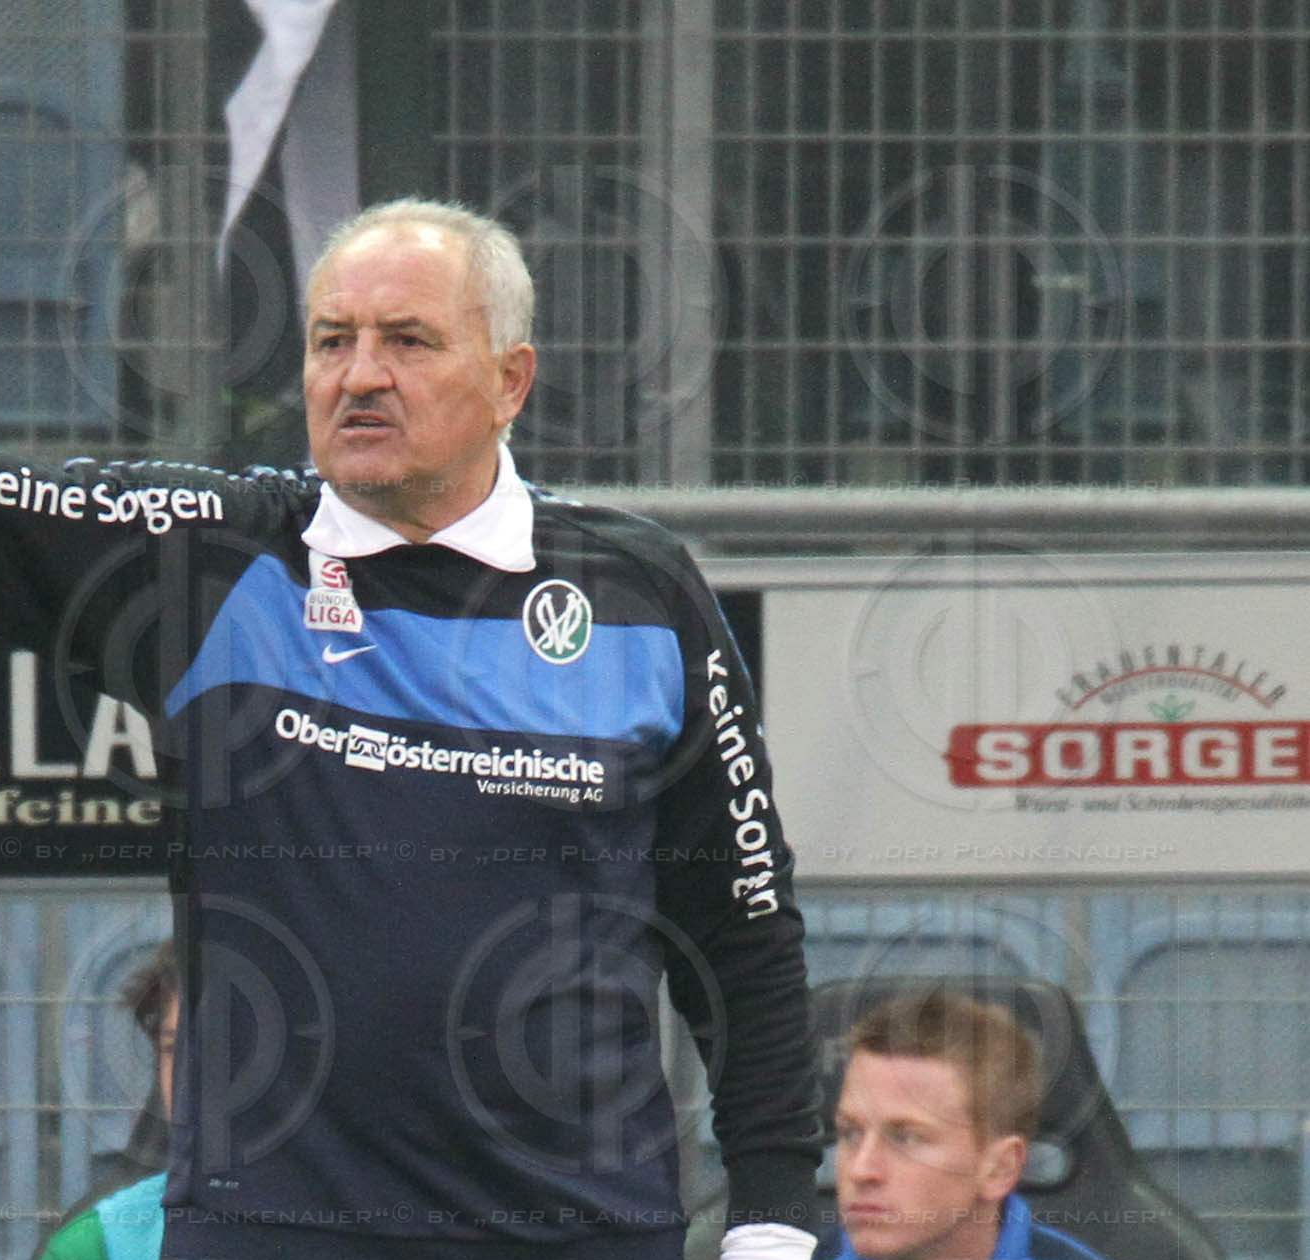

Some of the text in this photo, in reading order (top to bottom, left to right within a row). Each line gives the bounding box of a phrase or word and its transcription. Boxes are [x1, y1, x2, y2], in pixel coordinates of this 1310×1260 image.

[307, 605, 356, 625] LIGA
[274, 708, 605, 784] Ober österreichische
[477, 778, 604, 803] Versicherung AG
